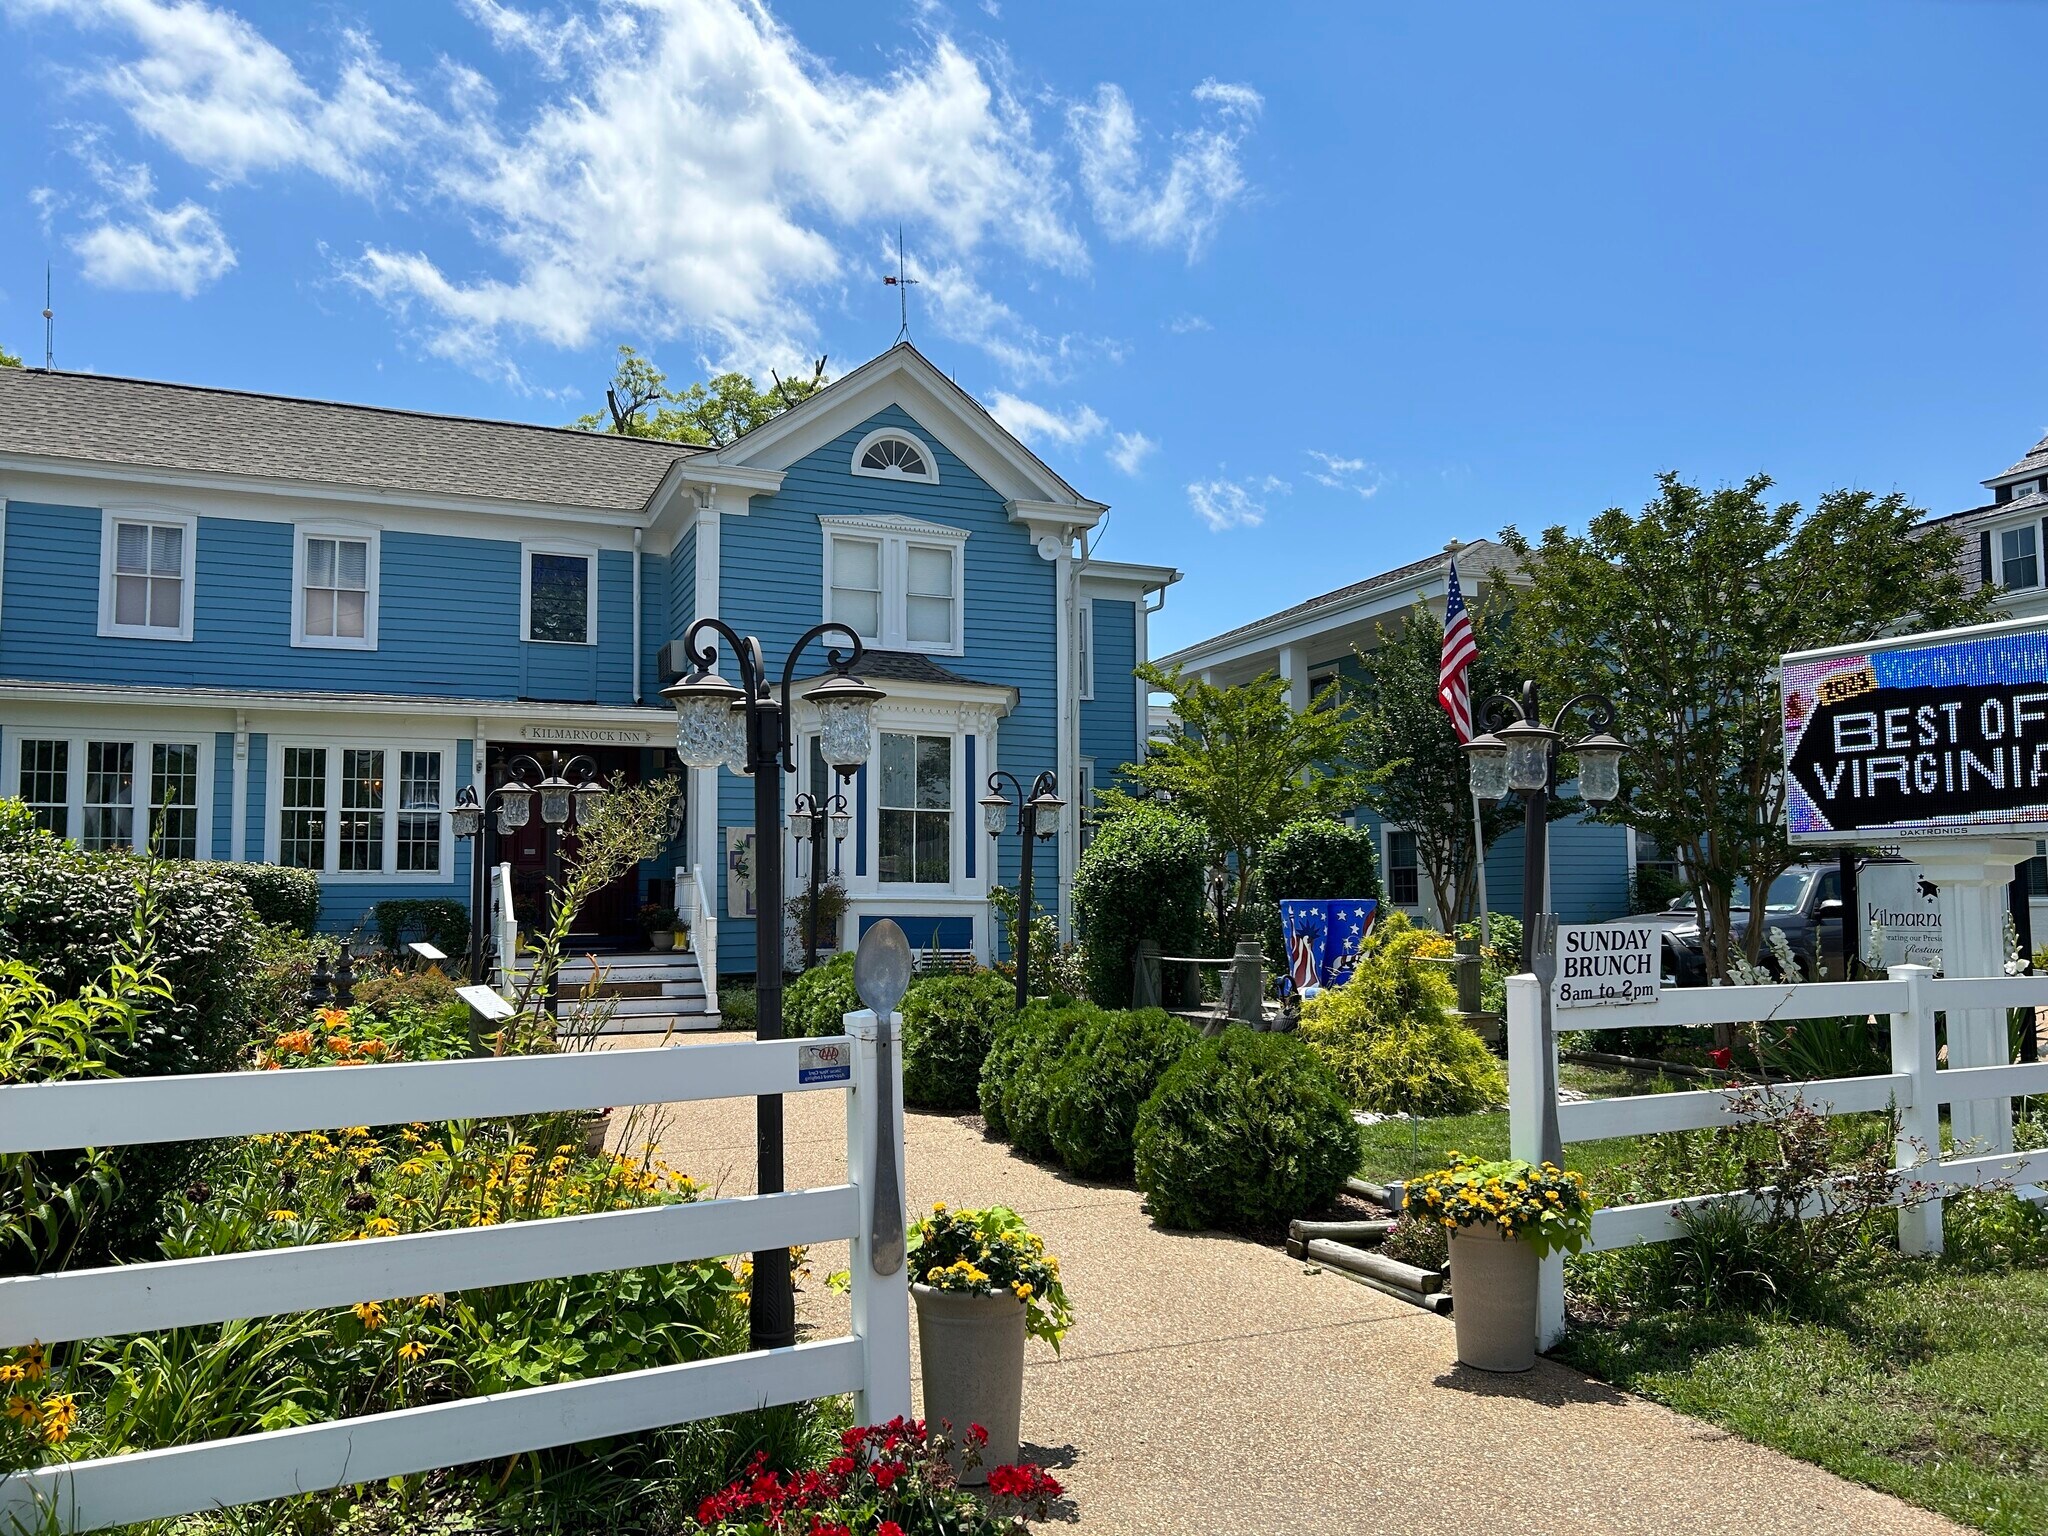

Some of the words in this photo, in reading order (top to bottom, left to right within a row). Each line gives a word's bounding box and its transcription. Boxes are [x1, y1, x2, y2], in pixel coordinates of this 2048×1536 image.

[1825, 672, 1870, 699] 2023
[532, 728, 615, 741] KILMARNOCK
[619, 731, 641, 742] INN
[1833, 702, 1962, 753] BEST
[1980, 693, 2048, 740] OF
[1813, 744, 2048, 800] VIRGINIA
[1900, 827, 1968, 836] DAKTRONICS
[1566, 929, 1652, 953] SUNDAY
[1905, 944, 1943, 954] Restaur
[1564, 954, 1652, 978] BRUNCH
[1560, 983, 1593, 1002] 8am
[1599, 982, 1615, 999] to
[1622, 980, 1654, 1000] 2pm
